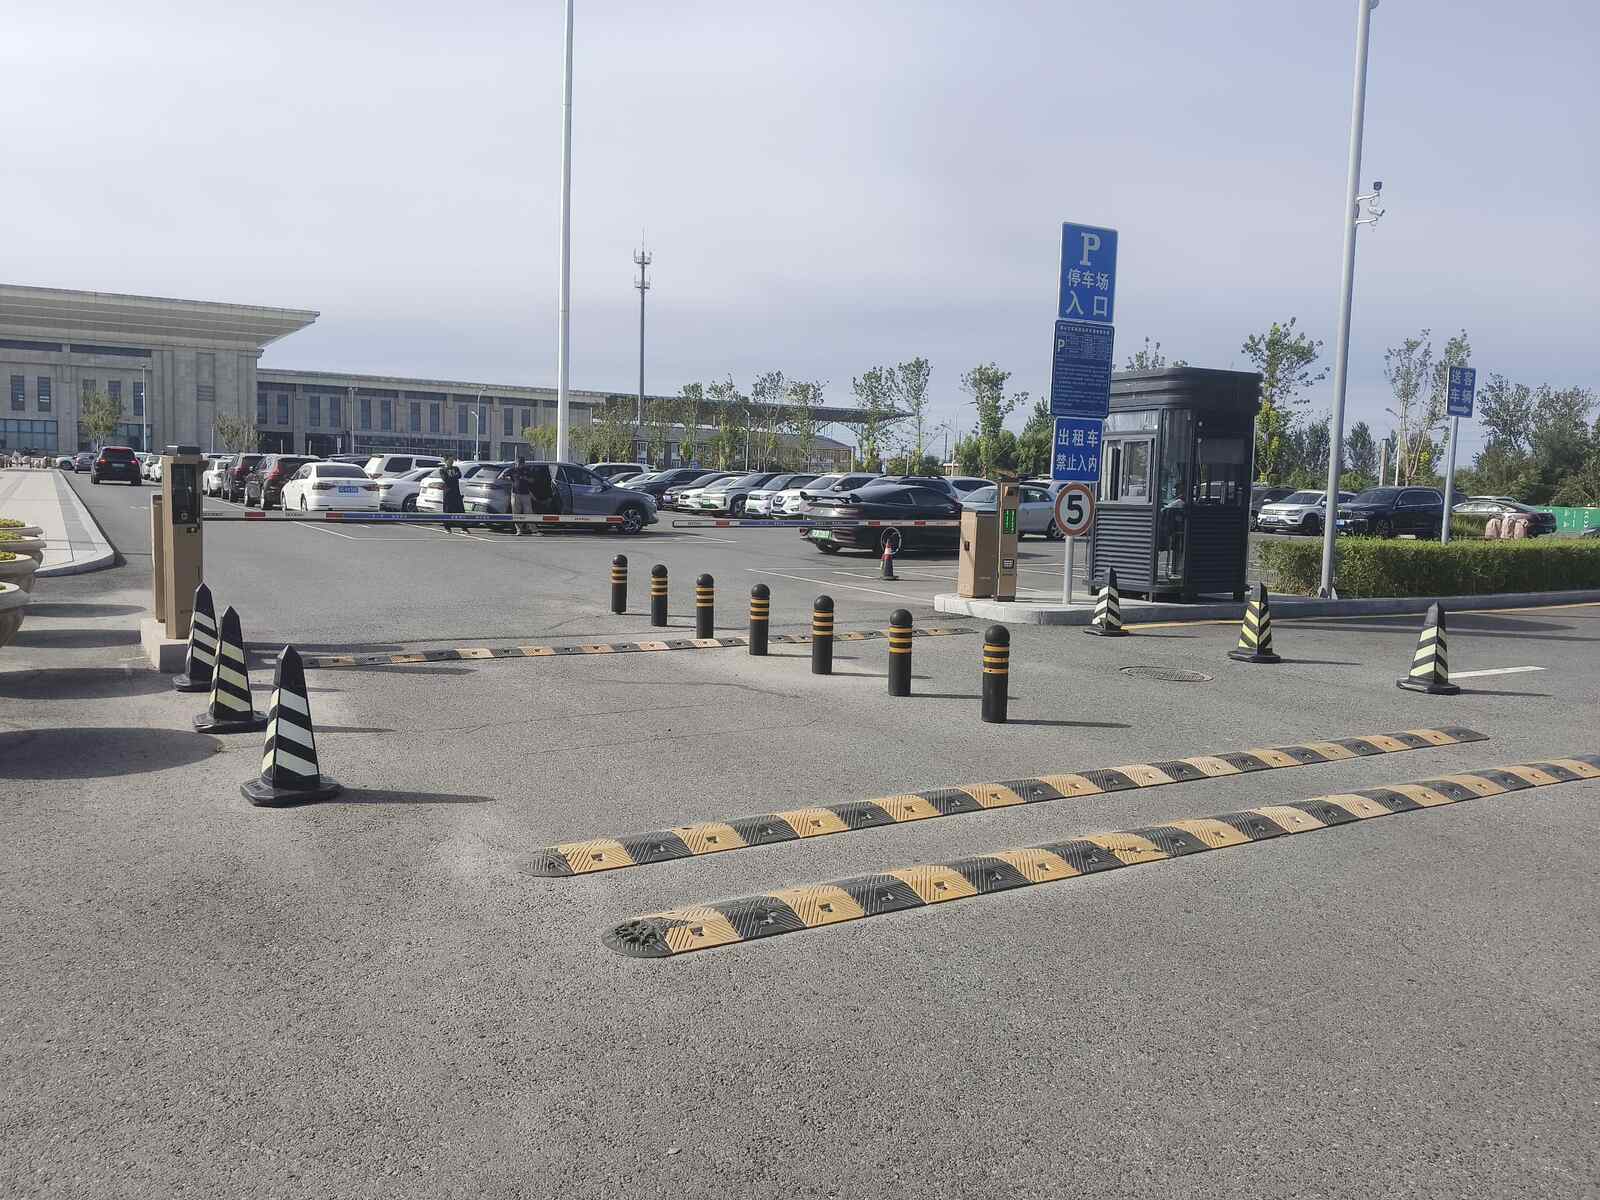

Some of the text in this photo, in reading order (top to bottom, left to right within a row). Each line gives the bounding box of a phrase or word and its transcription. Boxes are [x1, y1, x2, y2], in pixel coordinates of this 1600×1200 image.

[1080, 232, 1101, 266] P
[1068, 267, 1110, 291] 停车场
[1065, 290, 1108, 317] 入口
[1057, 427, 1099, 448] 出租车
[1055, 452, 1098, 473] 禁止入内
[1066, 494, 1084, 525] 5
